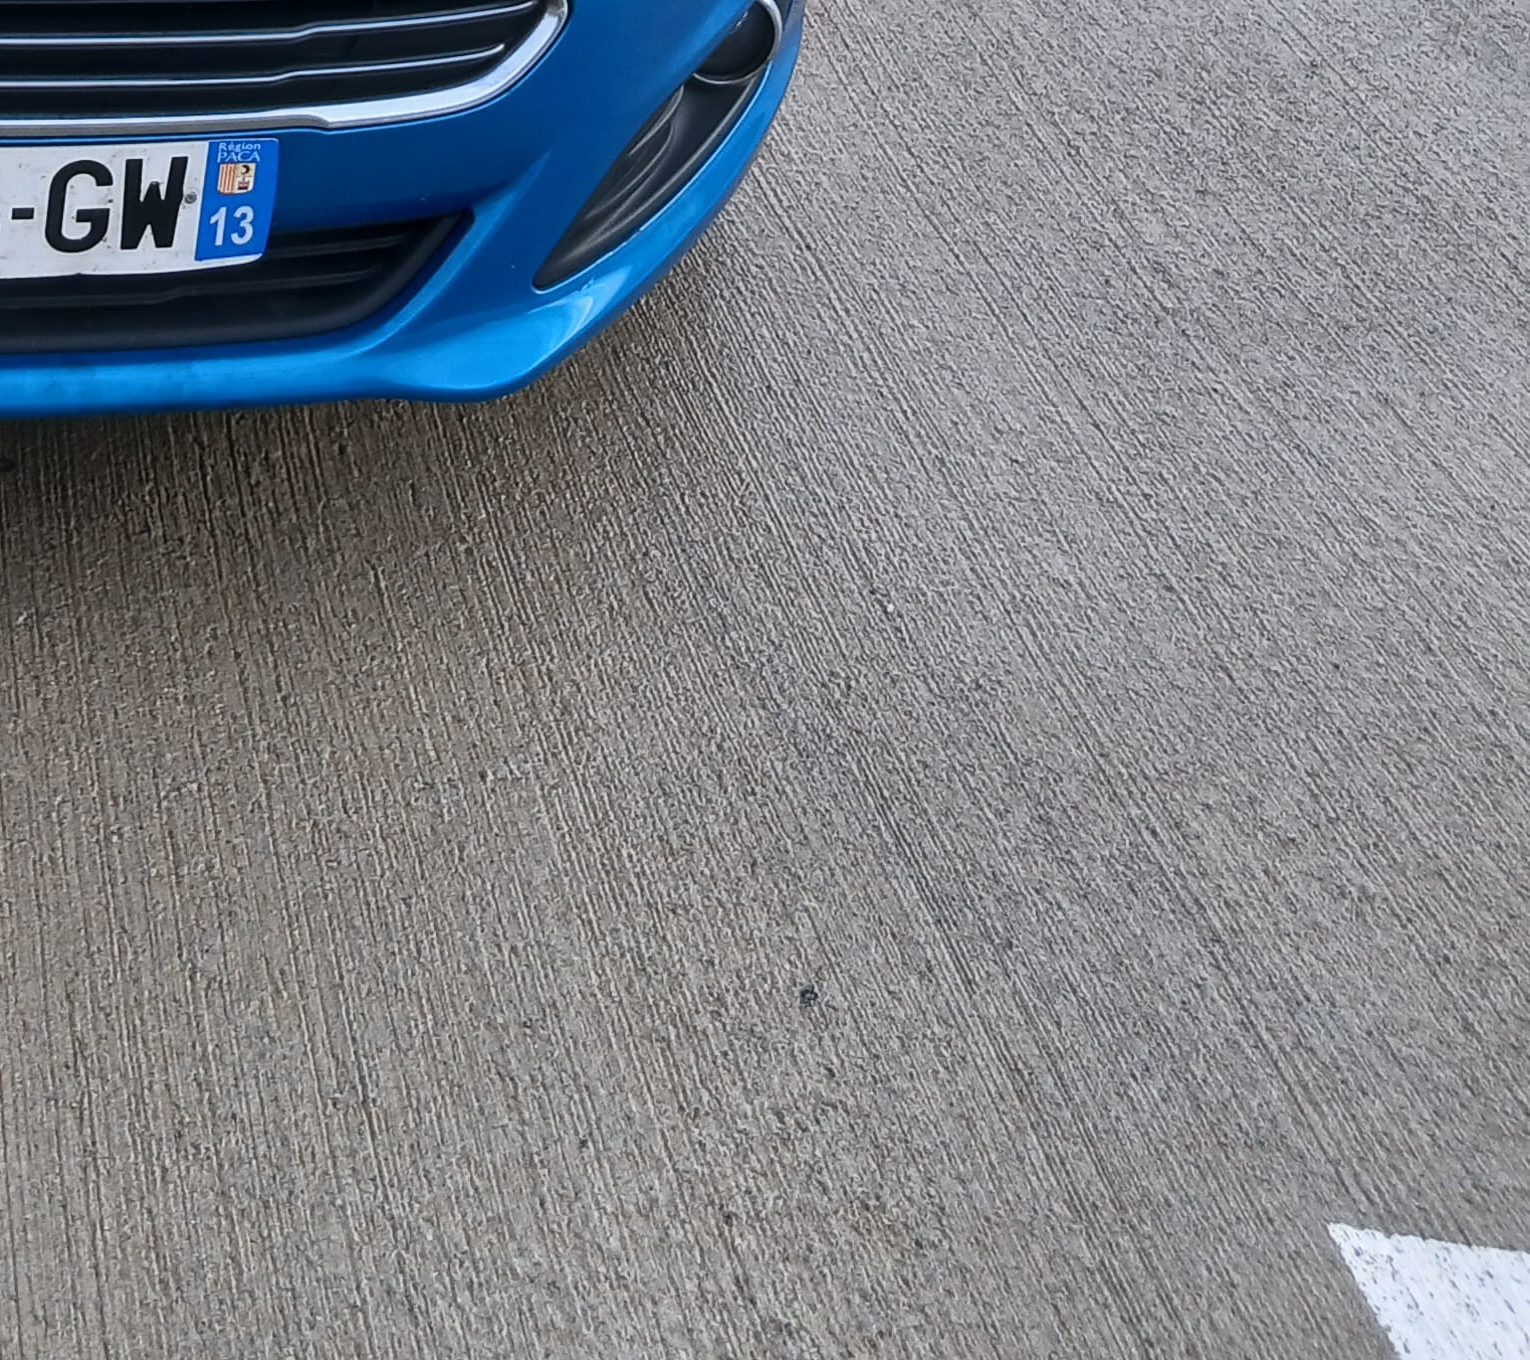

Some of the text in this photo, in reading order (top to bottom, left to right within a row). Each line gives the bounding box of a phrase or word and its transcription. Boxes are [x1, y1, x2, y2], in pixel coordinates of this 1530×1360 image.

[218, 142, 262, 153] Région
[217, 150, 261, 163] PACA
[210, 205, 254, 246] 13
